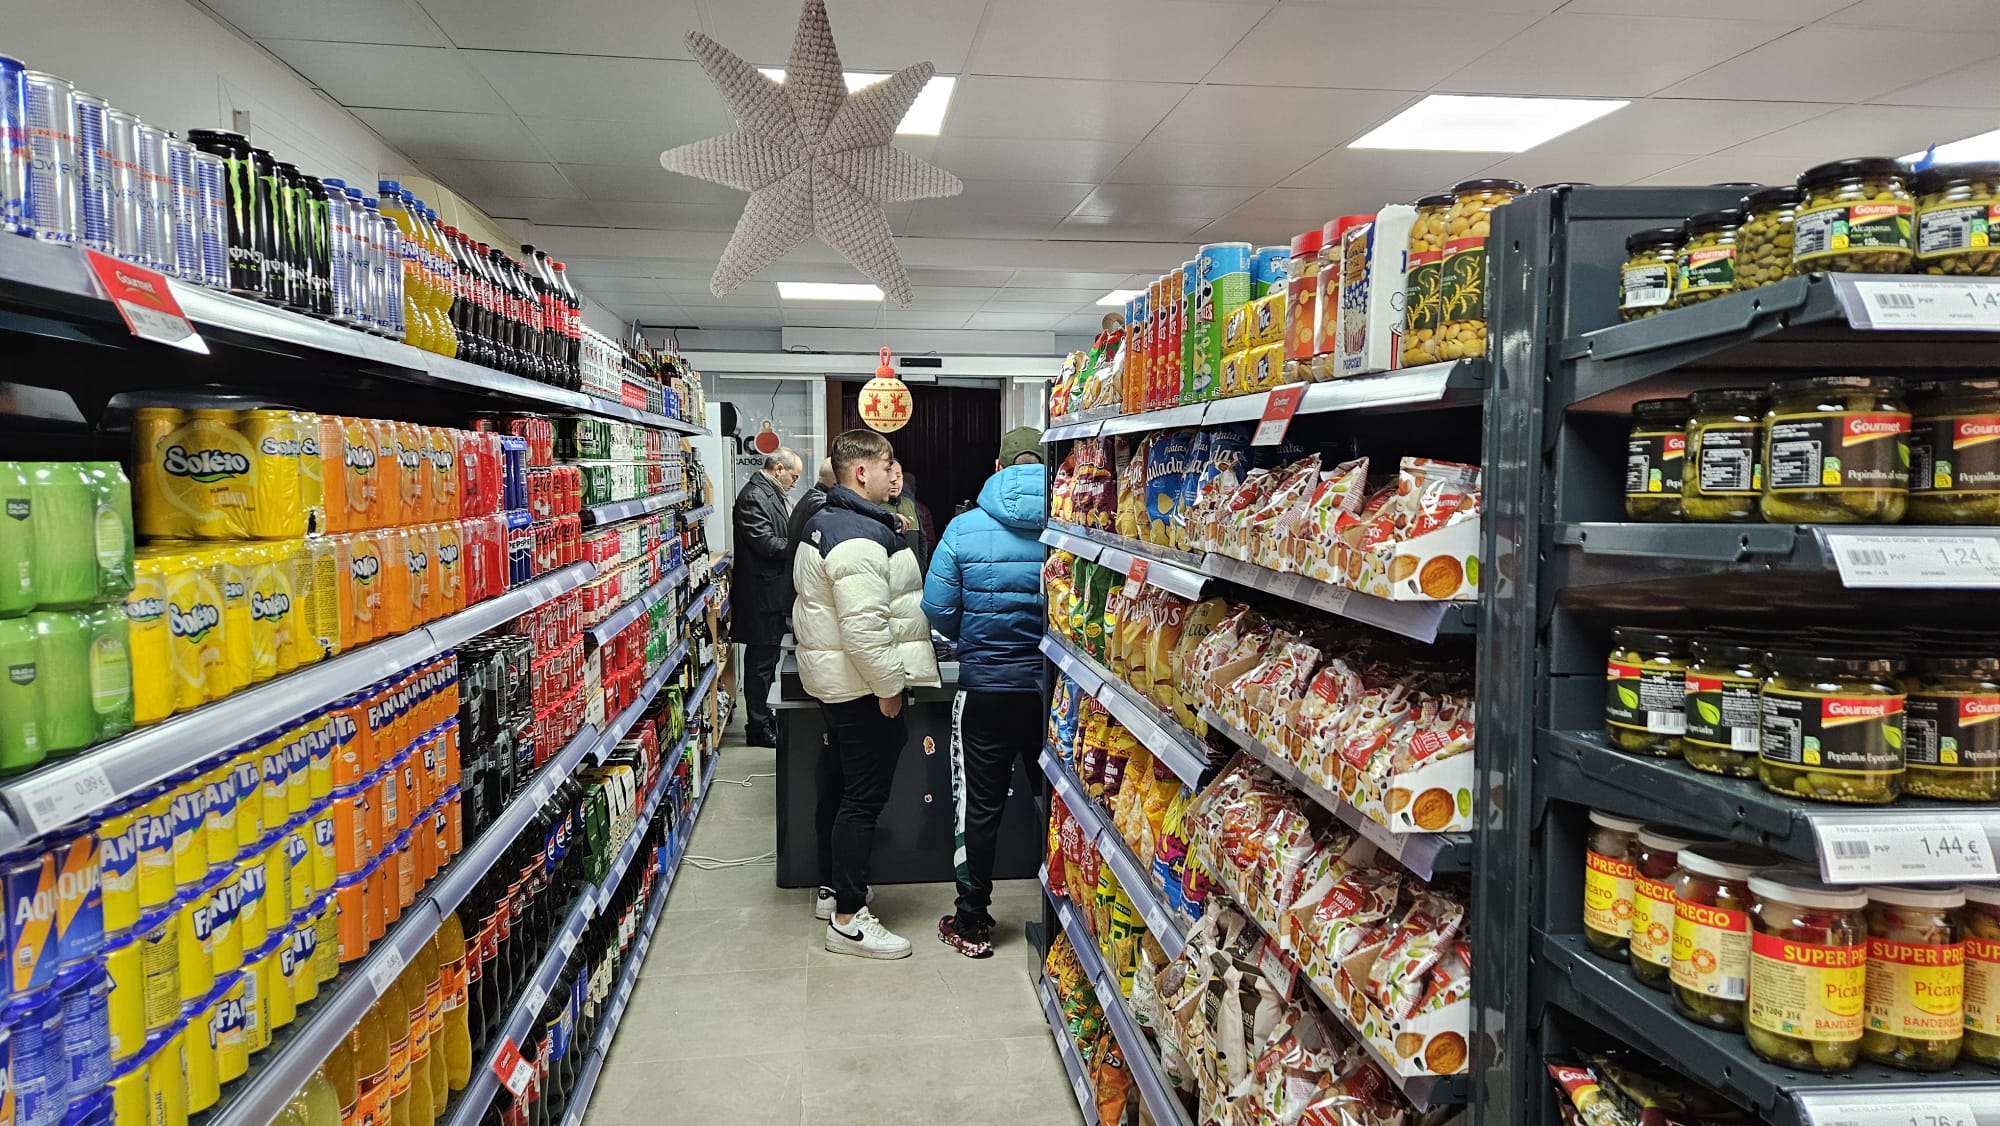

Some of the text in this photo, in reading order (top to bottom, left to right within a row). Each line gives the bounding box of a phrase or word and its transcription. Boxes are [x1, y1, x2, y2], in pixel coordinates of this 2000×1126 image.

[1855, 204, 1899, 214] Gourmet
[1851, 419, 1900, 433] Gourmet
[1848, 469, 1888, 483] Pepinillos
[1939, 547, 1982, 567] 1,24
[1829, 702, 1885, 715] Gourmet
[1827, 751, 1867, 763] Pepinillos
[1921, 836, 1980, 858] 1,44 €
[1676, 901, 1731, 928] PRECIO
[1784, 944, 1848, 965] SUPER
[1873, 942, 1938, 964] SUPER
